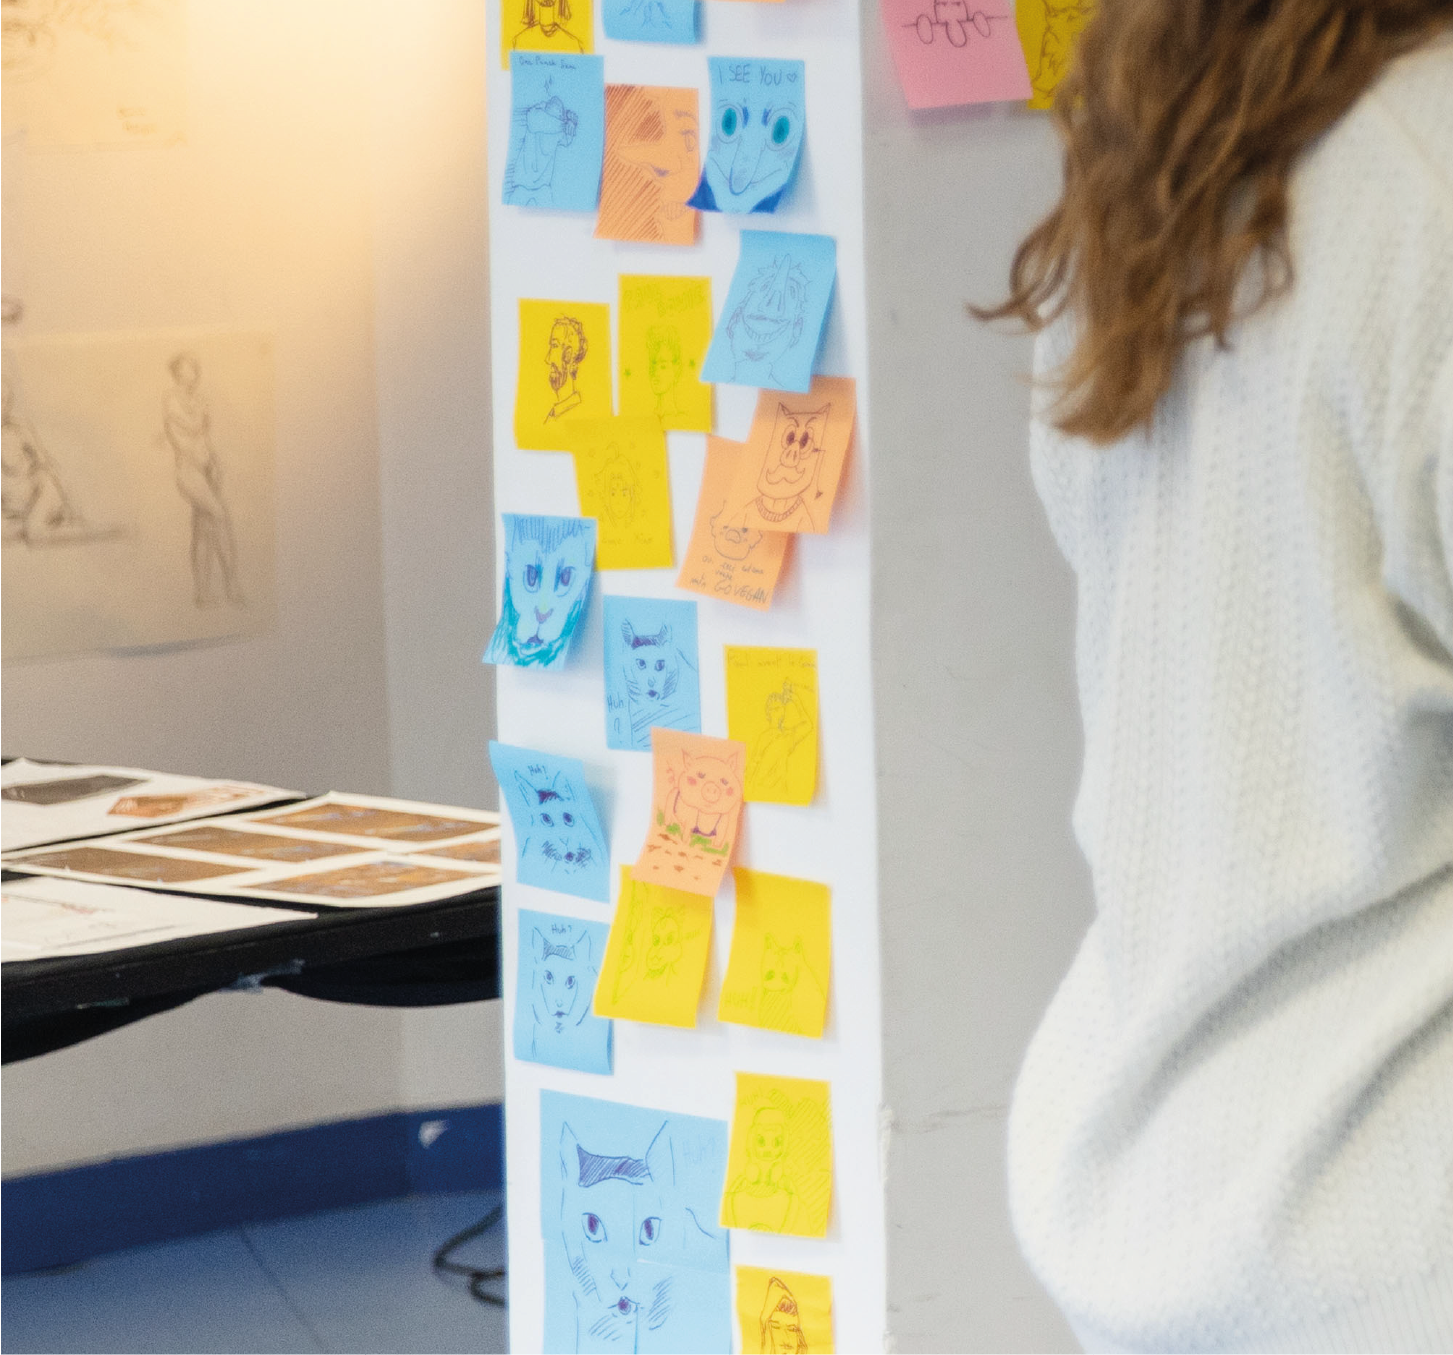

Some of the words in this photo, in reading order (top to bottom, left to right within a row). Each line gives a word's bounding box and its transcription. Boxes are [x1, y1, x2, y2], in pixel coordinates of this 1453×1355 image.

[728, 63, 751, 84] SEE
[759, 66, 783, 87] YOU
[551, 922, 573, 935] Huh?
